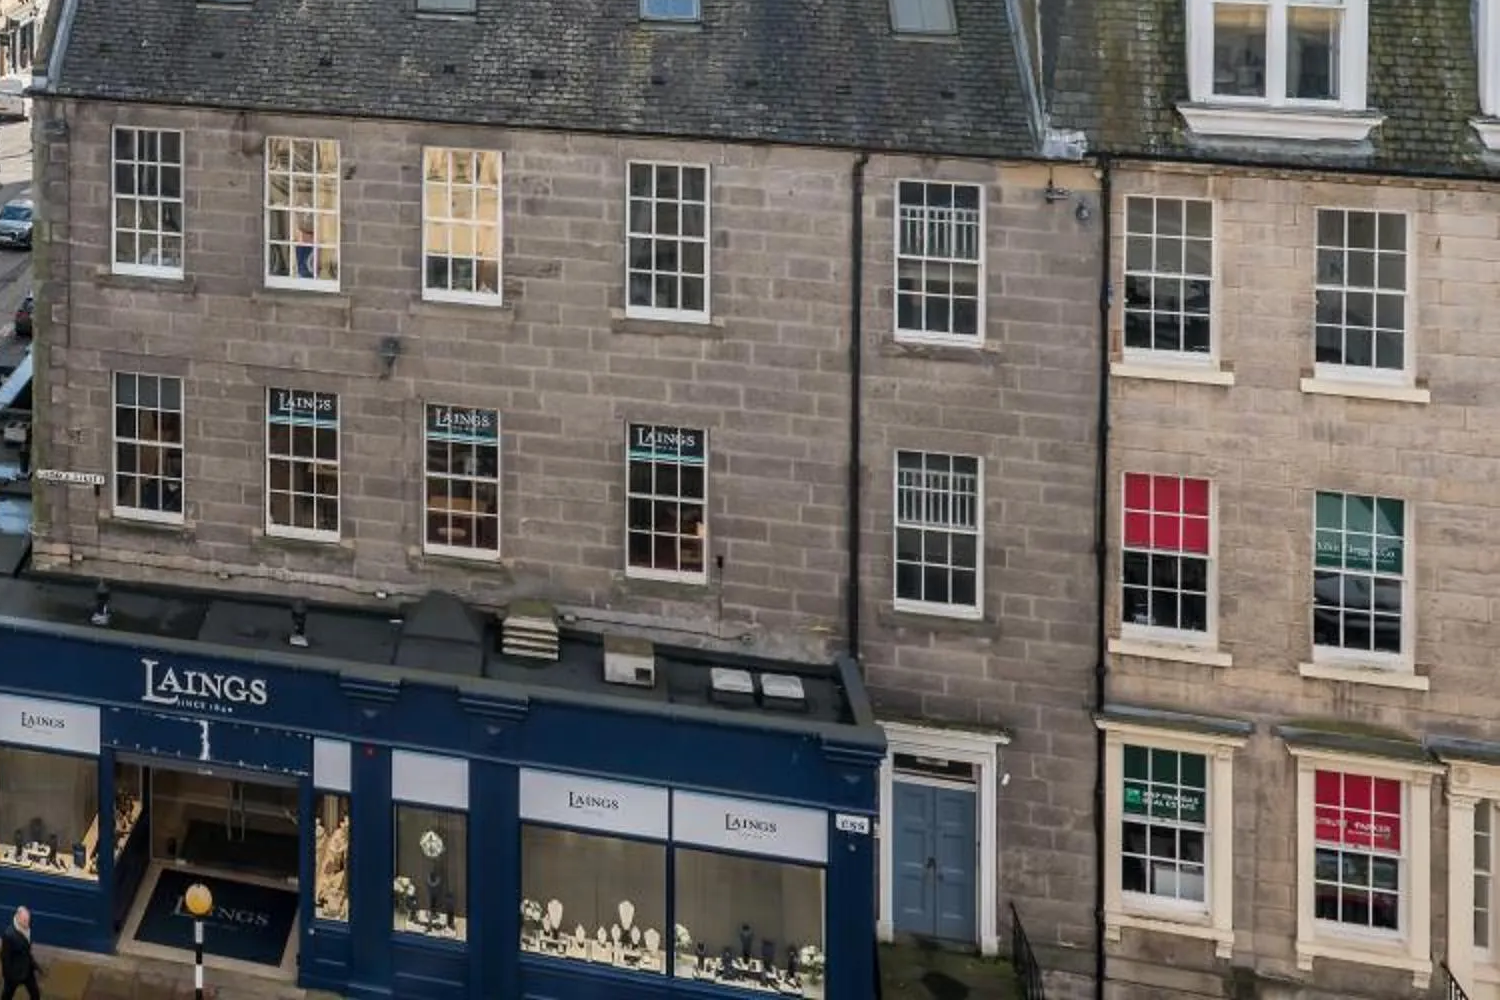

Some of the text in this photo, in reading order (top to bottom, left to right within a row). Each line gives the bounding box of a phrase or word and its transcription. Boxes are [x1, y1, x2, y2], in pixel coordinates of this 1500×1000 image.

[277, 392, 332, 412] LAINGS
[434, 407, 491, 428] LAINGS
[636, 427, 696, 447] LAINGS
[140, 658, 268, 706] LAINGS
[21, 711, 66, 730] LAINGS
[568, 790, 620, 811] LAINGS
[724, 813, 778, 834] LAINGS
[173, 896, 269, 926] LNGS
